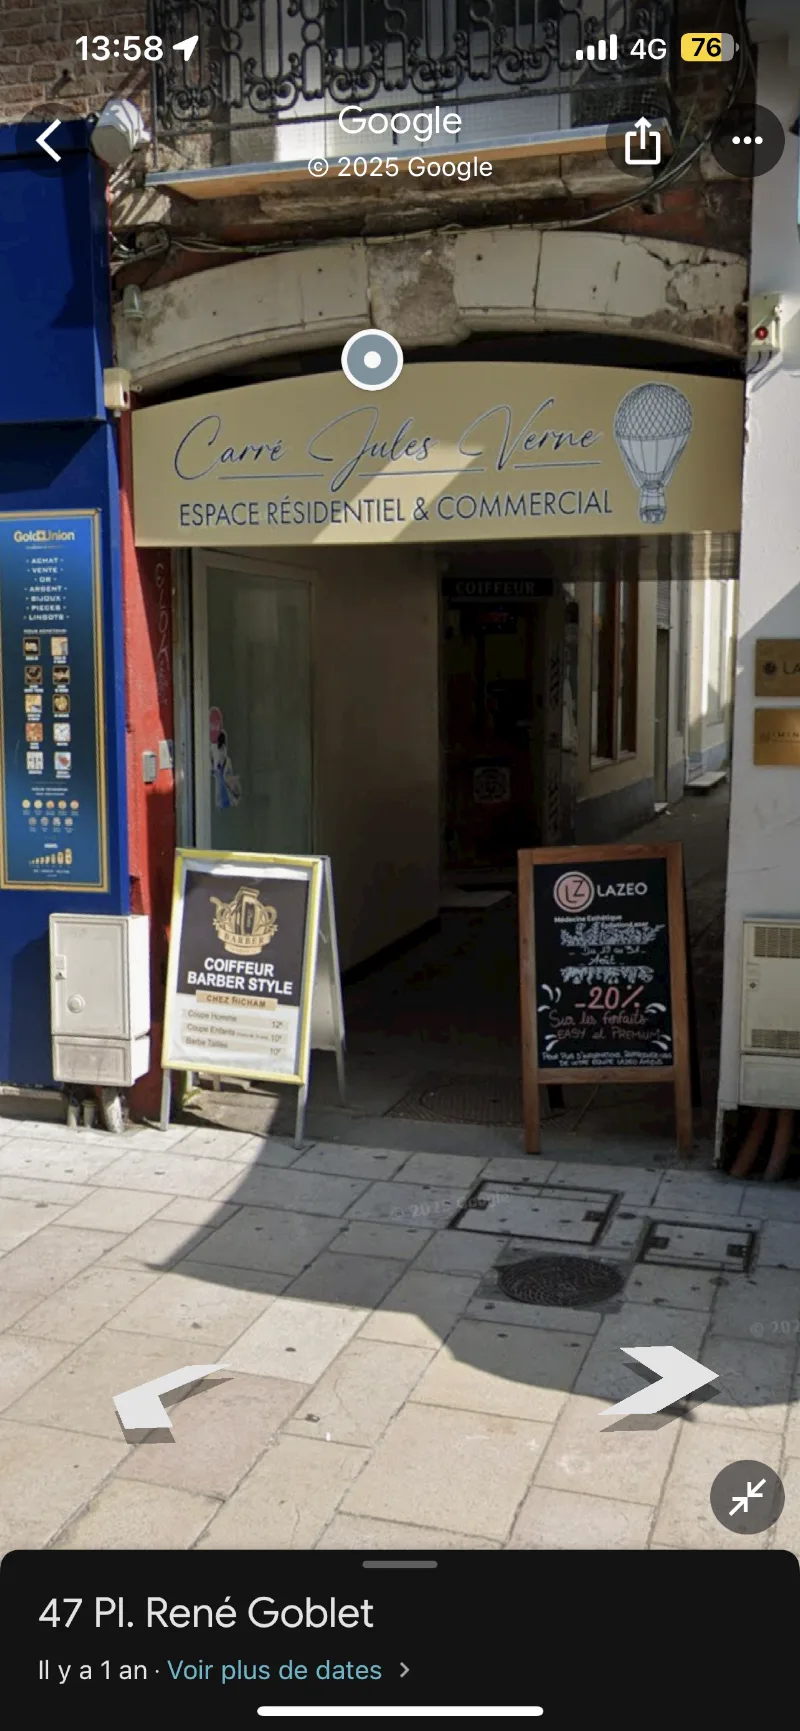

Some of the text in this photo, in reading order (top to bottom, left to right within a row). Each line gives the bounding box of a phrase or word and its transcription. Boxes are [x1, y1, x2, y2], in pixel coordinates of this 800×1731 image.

[173, 398, 602, 492] Carré Jules Verne
[179, 489, 614, 527] ESPACE RÉSIDENTIEL & COMMERCIAL
[455, 580, 536, 595] COIFFEUR
[597, 882, 648, 897] LAZEO
[224, 933, 265, 946] BARBER
[204, 957, 275, 977] COIFFEUR
[187, 970, 293, 996] BARBER STYLE
[206, 994, 229, 1005] CHEZ
[575, 985, 645, 1010] -20%
[187, 1009, 209, 1021] Coupe
[211, 1012, 237, 1023] Homme
[186, 1023, 209, 1035] Coupe
[557, 1029, 587, 1040] EASY
[612, 1029, 661, 1041] PREMIUM
